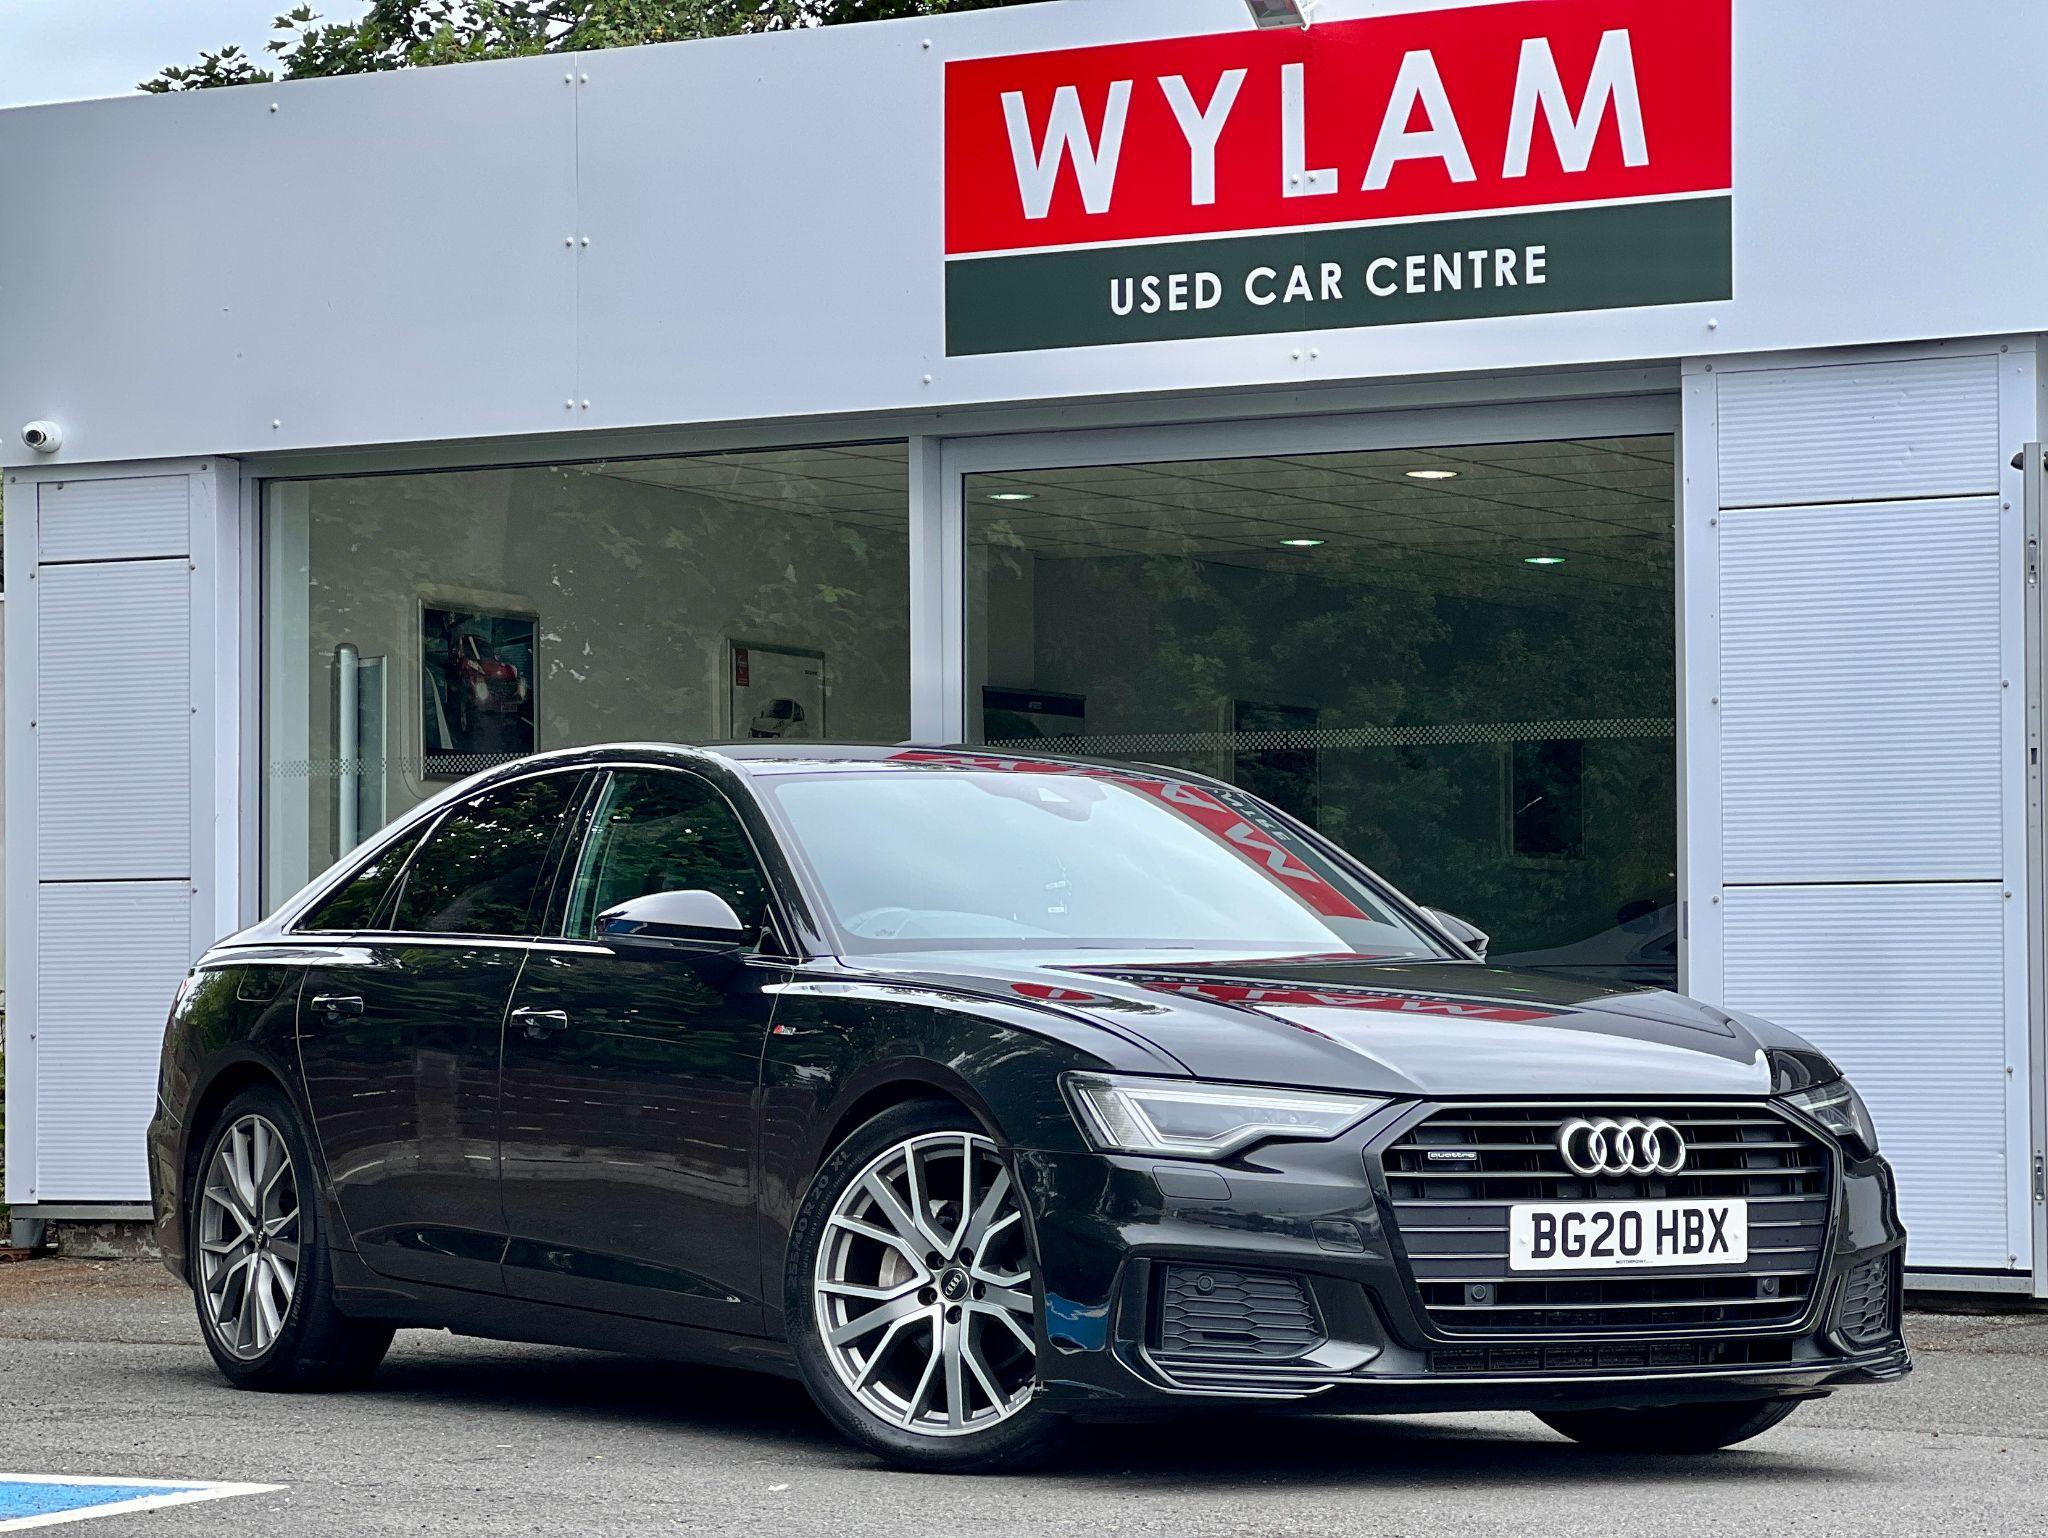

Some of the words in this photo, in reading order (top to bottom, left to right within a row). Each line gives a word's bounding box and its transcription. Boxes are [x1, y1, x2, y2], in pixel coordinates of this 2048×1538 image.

[1000, 28, 1650, 220] WYLAM
[1110, 271, 1222, 317] USED
[1245, 260, 1343, 307] CAR
[1366, 245, 1547, 297] CENTRE
[1531, 1211, 1642, 1259] BG20
[1657, 1207, 1730, 1255] HBX
